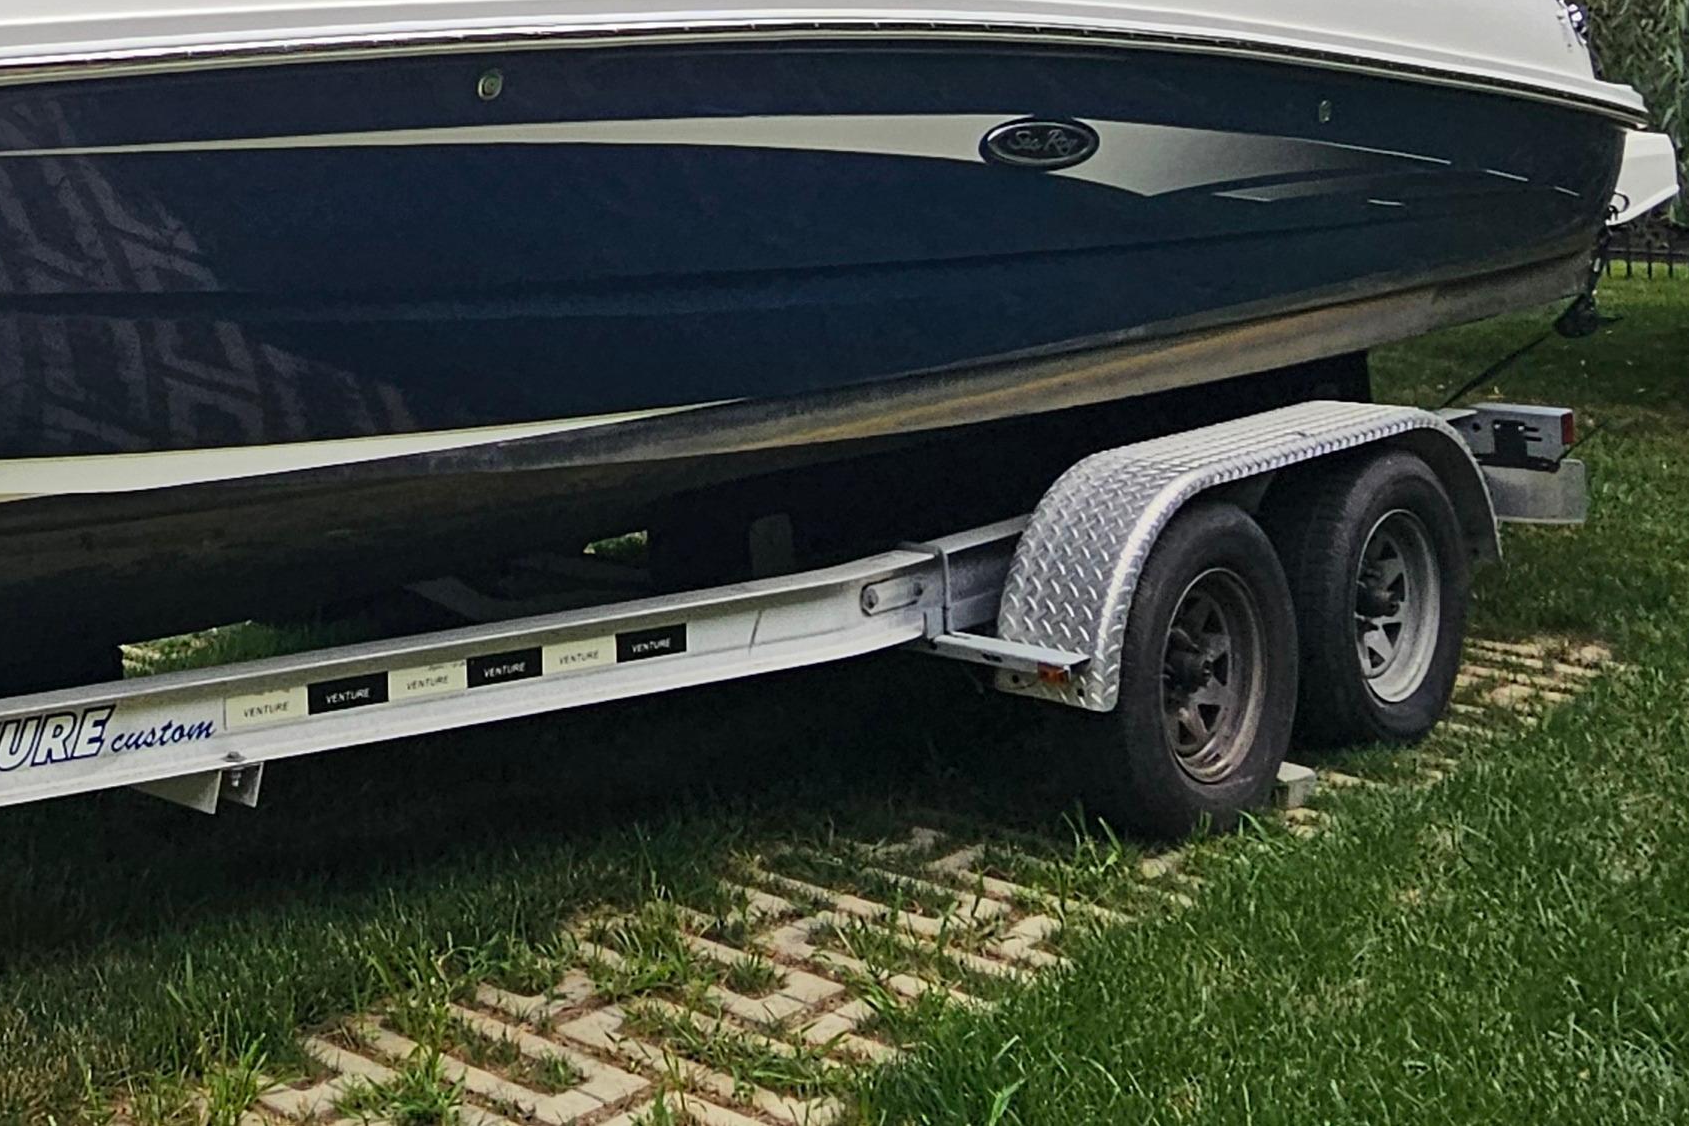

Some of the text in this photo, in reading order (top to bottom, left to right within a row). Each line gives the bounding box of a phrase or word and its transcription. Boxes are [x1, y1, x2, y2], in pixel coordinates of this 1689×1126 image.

[243, 637, 672, 719] VENTURE VENTURE VENTURE VENTURE VENTURE VENTURE
[111, 717, 216, 754] custom
